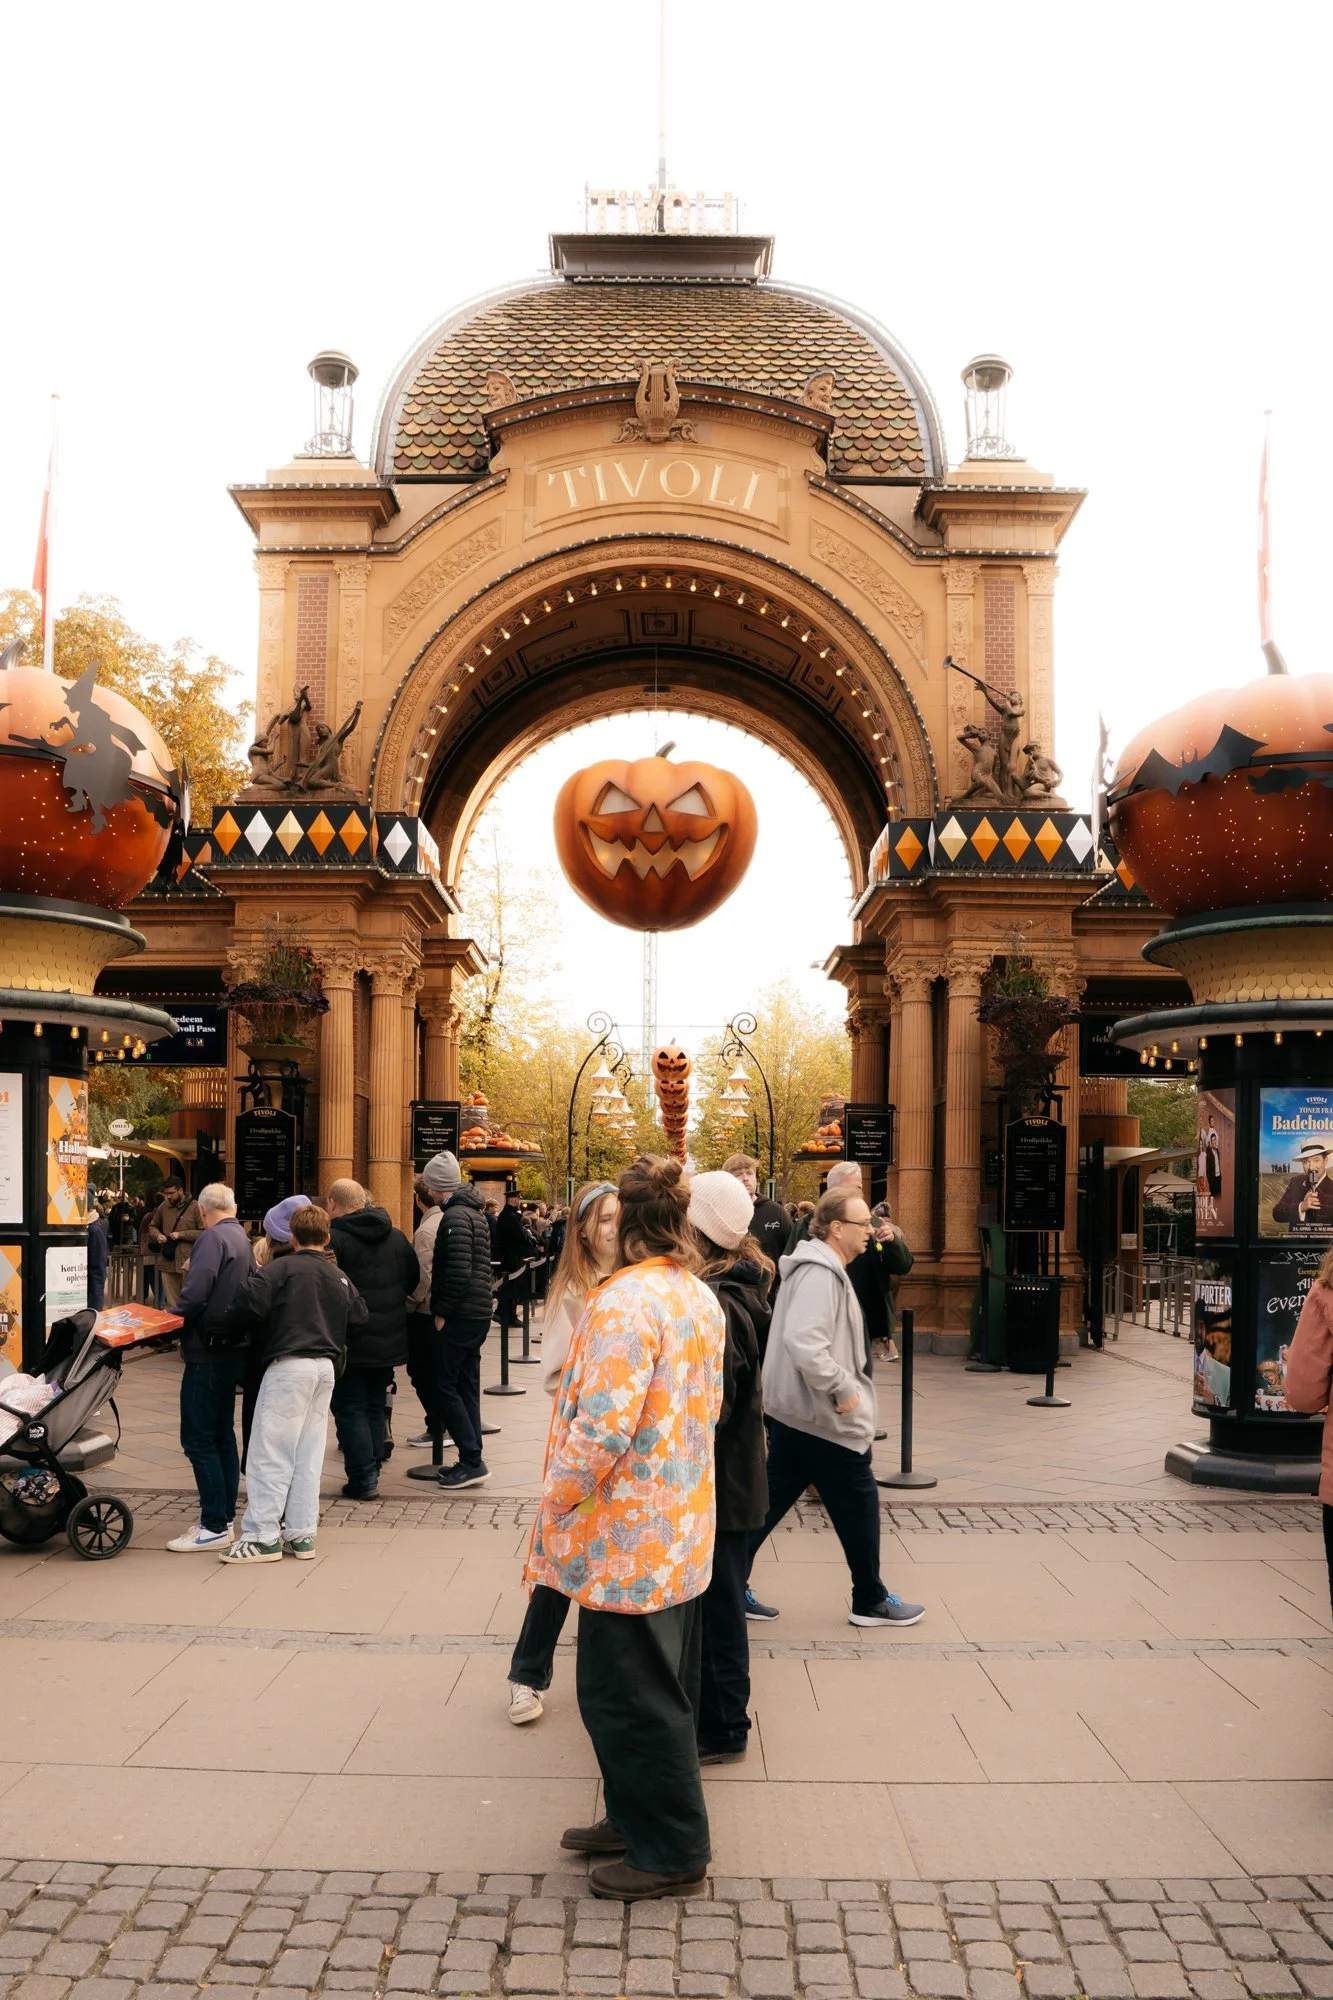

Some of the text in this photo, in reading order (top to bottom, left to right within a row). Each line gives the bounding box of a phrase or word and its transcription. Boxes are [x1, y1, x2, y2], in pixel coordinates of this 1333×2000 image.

[589, 188, 732, 235] TIVOLI
[548, 457, 761, 510] TIVOLI
[177, 1024, 216, 1033] ivoli Pass
[1305, 1096, 1328, 1104] TIVOLI
[253, 1109, 276, 1117] TIVOLI
[61, 1264, 76, 1273] Kort
[1200, 1284, 1232, 1306] PORTER
